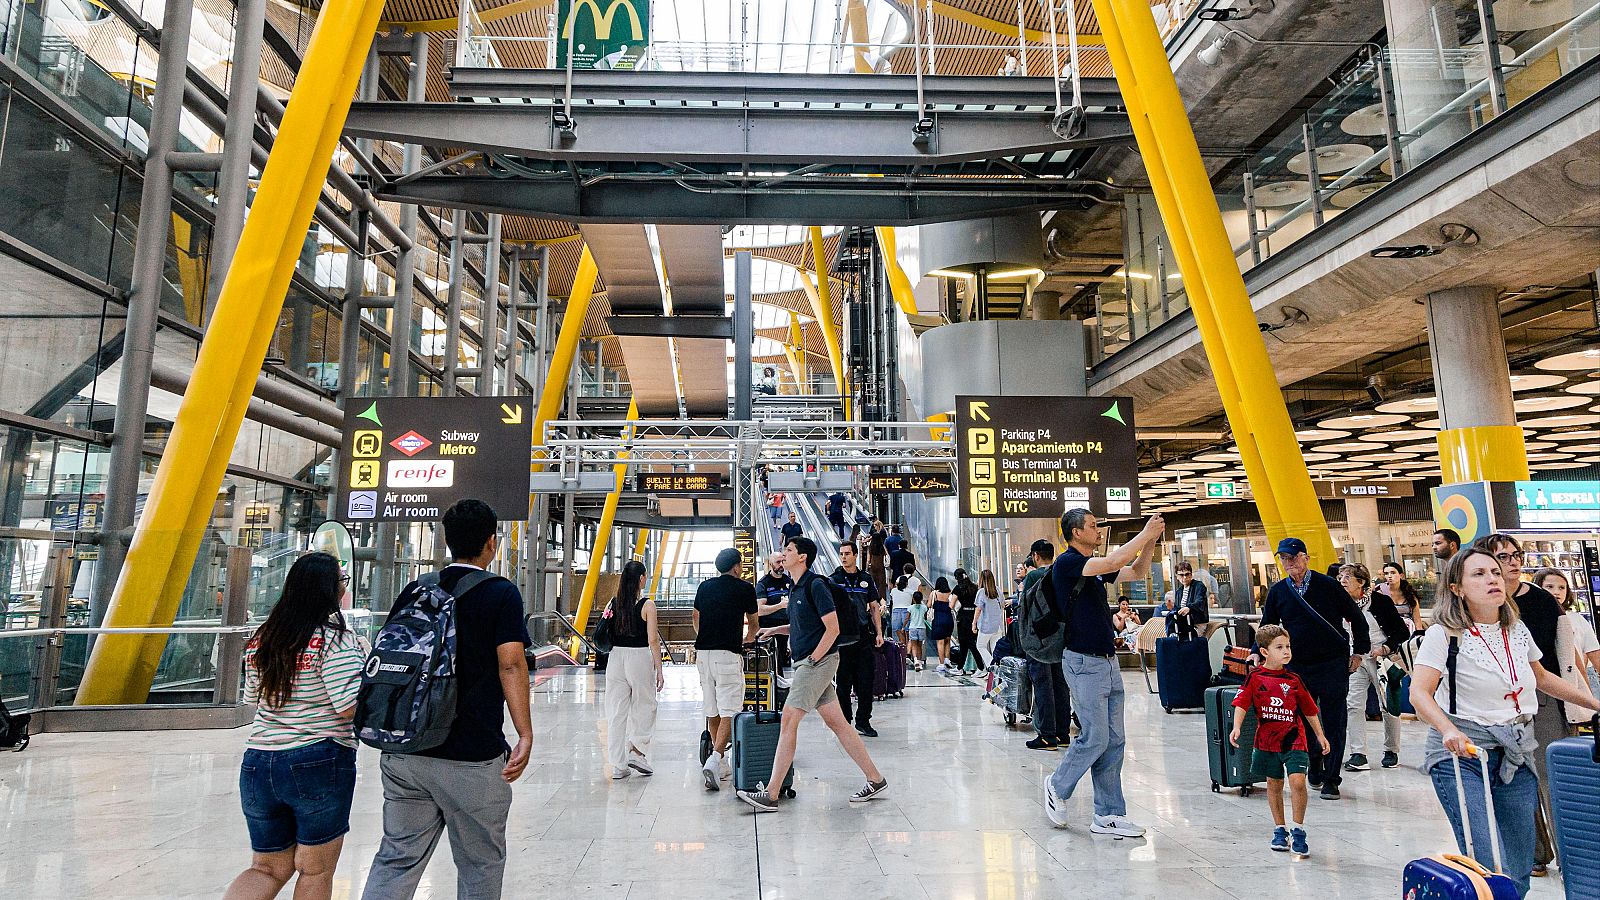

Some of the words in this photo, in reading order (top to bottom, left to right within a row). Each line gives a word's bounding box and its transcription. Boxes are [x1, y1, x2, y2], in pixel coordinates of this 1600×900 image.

[441, 430, 480, 443] Subway
[975, 433, 989, 450] P
[1001, 429, 1035, 442] Parking
[1037, 429, 1051, 440] P4
[439, 443, 477, 455] Metro
[1001, 442, 1084, 456] Aparcamiento
[1087, 441, 1103, 454] P4
[1002, 458, 1020, 469] Bus
[1023, 458, 1062, 469] Terminal
[1064, 458, 1077, 469] T4
[394, 463, 448, 483] renfe
[1002, 471, 1055, 483] Terminal
[1058, 471, 1081, 483] Bus
[1082, 471, 1100, 483] T4
[870, 478, 902, 489] HERE
[384, 492, 399, 503] Air
[401, 493, 428, 503] room
[1003, 488, 1057, 501] Ridesharing
[1066, 489, 1087, 498] Uber
[1109, 488, 1127, 497] Bolt
[383, 505, 402, 517] Air
[405, 506, 439, 517] room
[1003, 500, 1028, 513] VTC
[1261, 706, 1294, 716] MIRANDA
